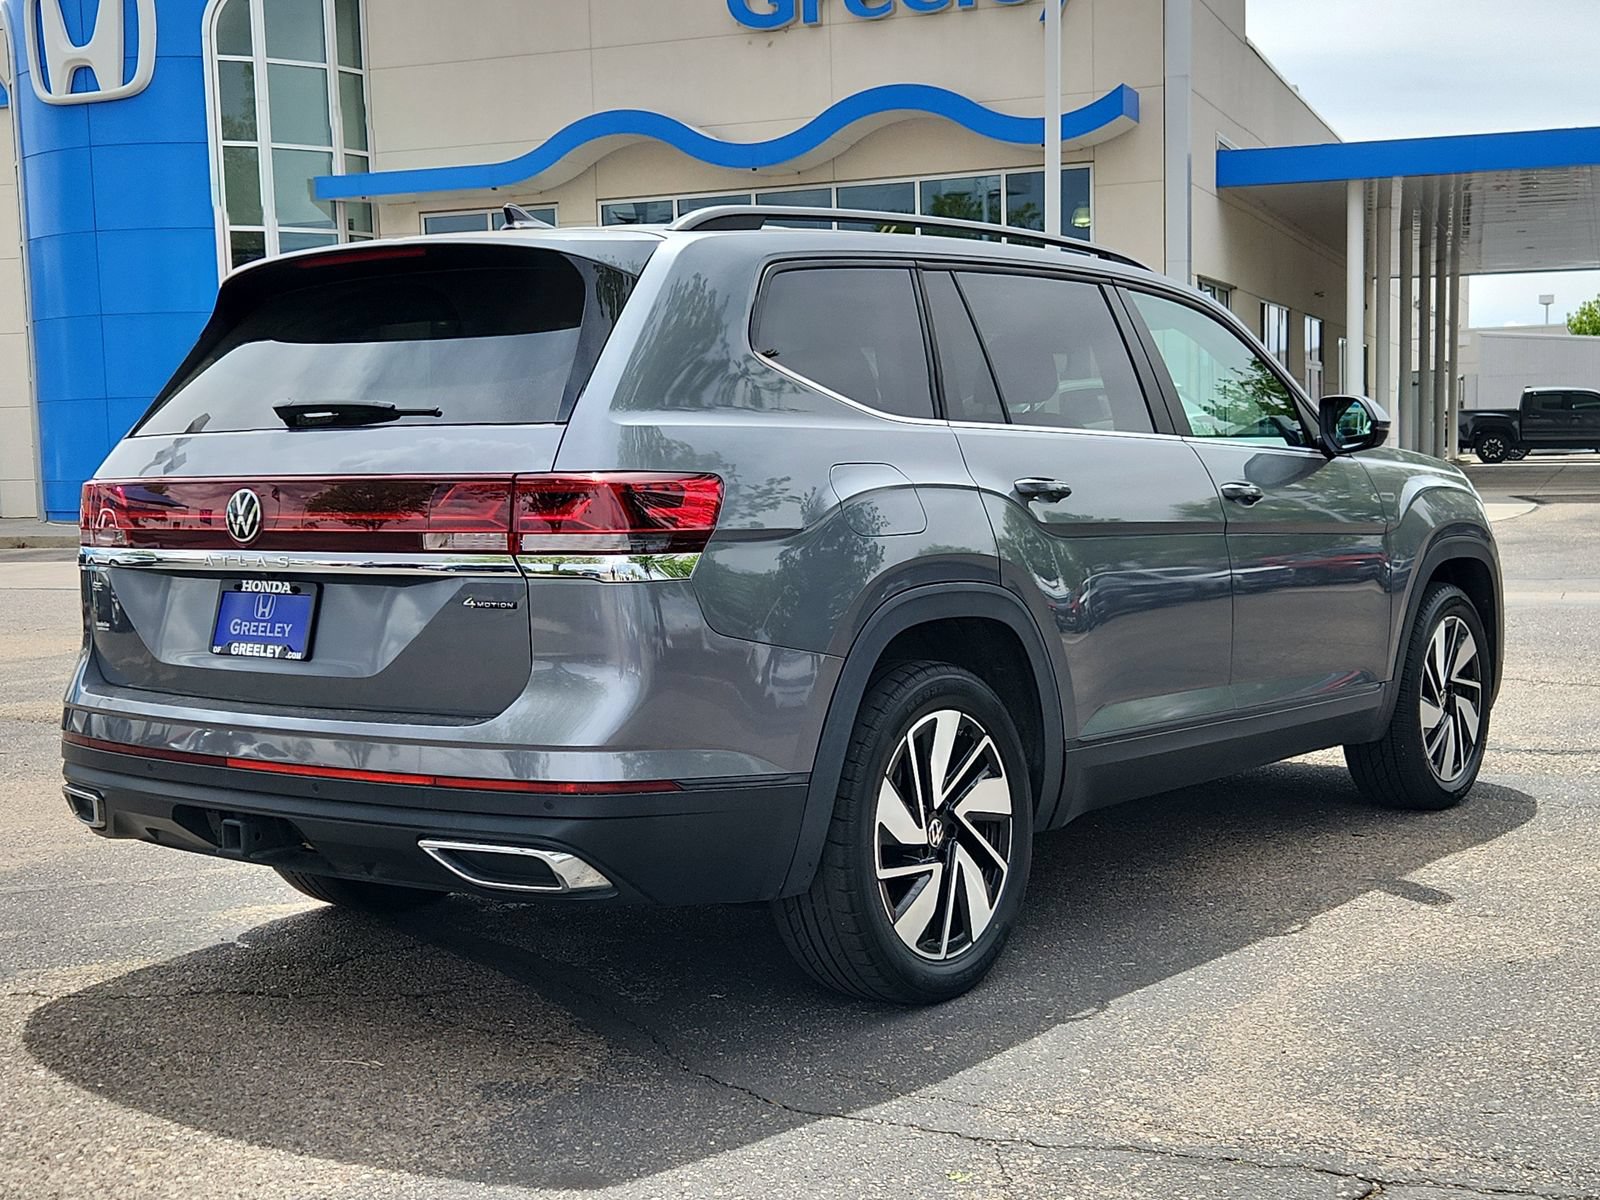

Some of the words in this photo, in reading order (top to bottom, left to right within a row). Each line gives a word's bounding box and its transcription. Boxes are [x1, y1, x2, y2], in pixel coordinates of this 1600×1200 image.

[203, 554, 290, 569] ATLAS
[240, 579, 292, 594] HONDA
[229, 618, 293, 638] GREELEY
[212, 645, 222, 654] OF
[230, 642, 283, 658] GREELEY
